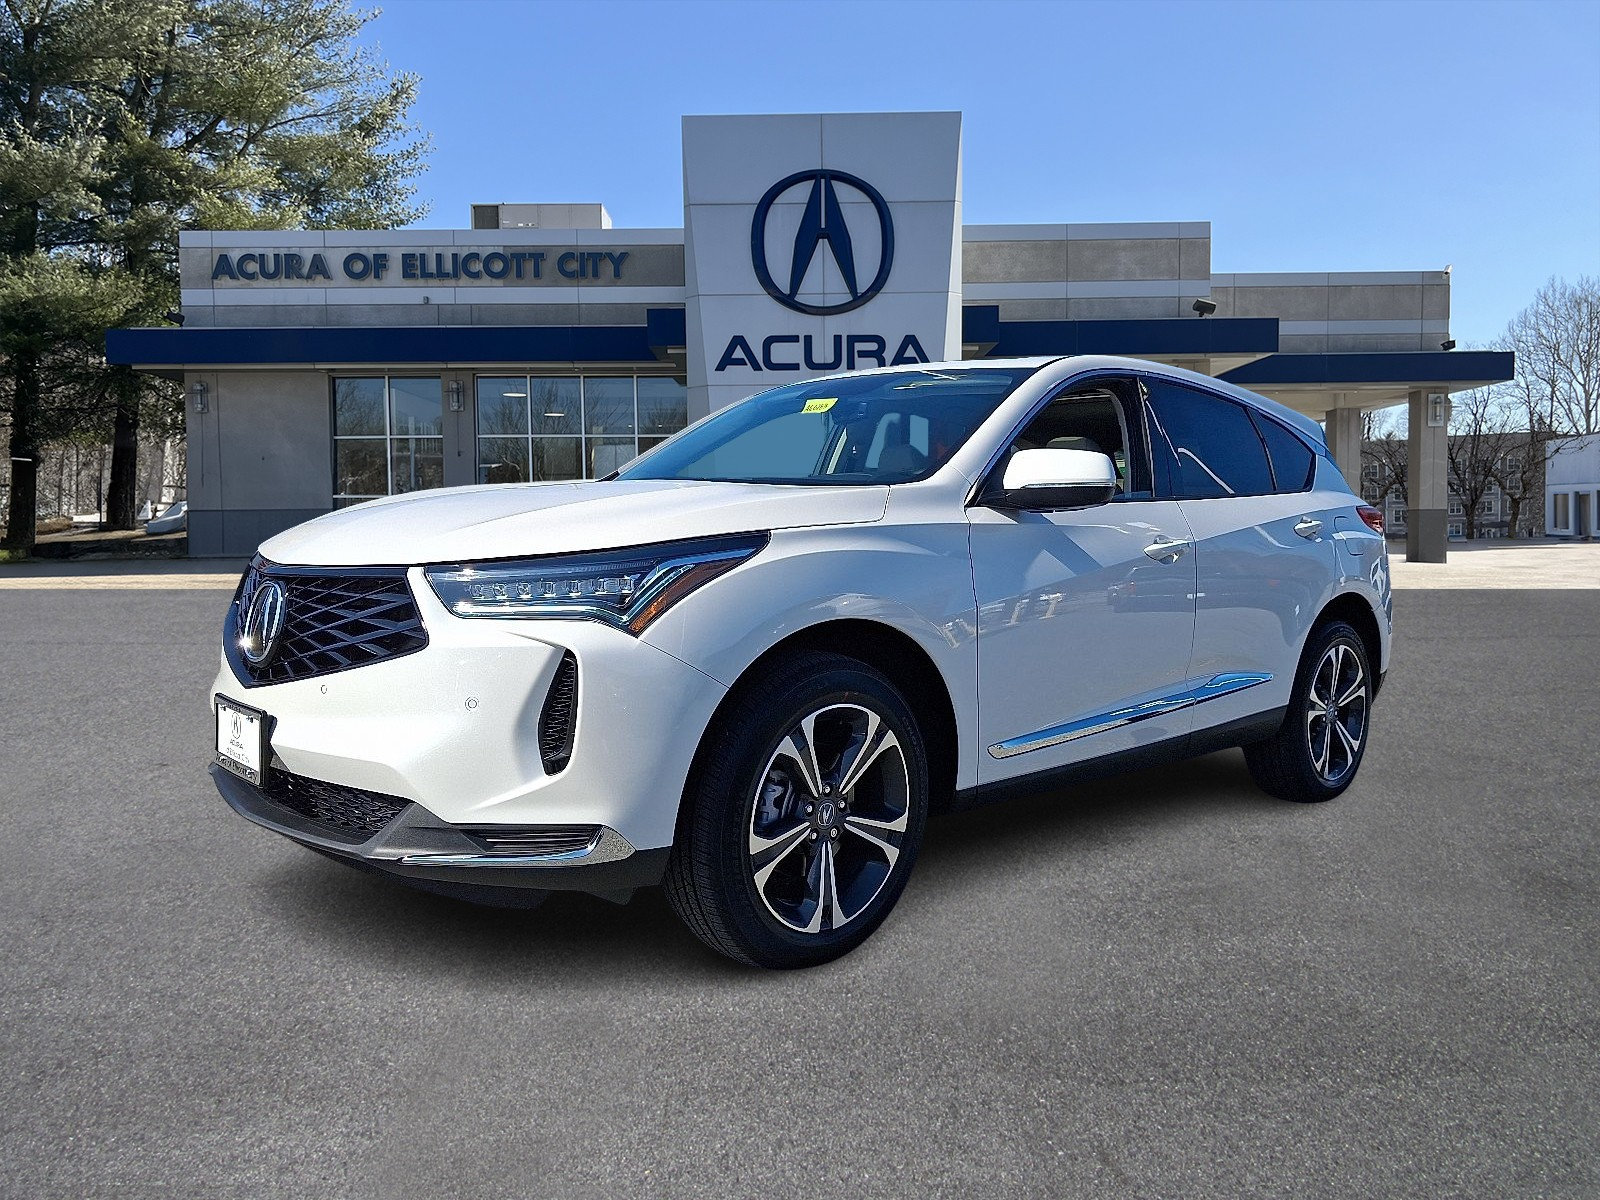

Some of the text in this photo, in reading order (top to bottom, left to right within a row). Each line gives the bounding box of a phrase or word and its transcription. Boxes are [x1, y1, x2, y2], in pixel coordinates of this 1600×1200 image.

[211, 251, 628, 280] ACURA OF ELLICOTT CITY
[714, 334, 931, 371] ACURA
